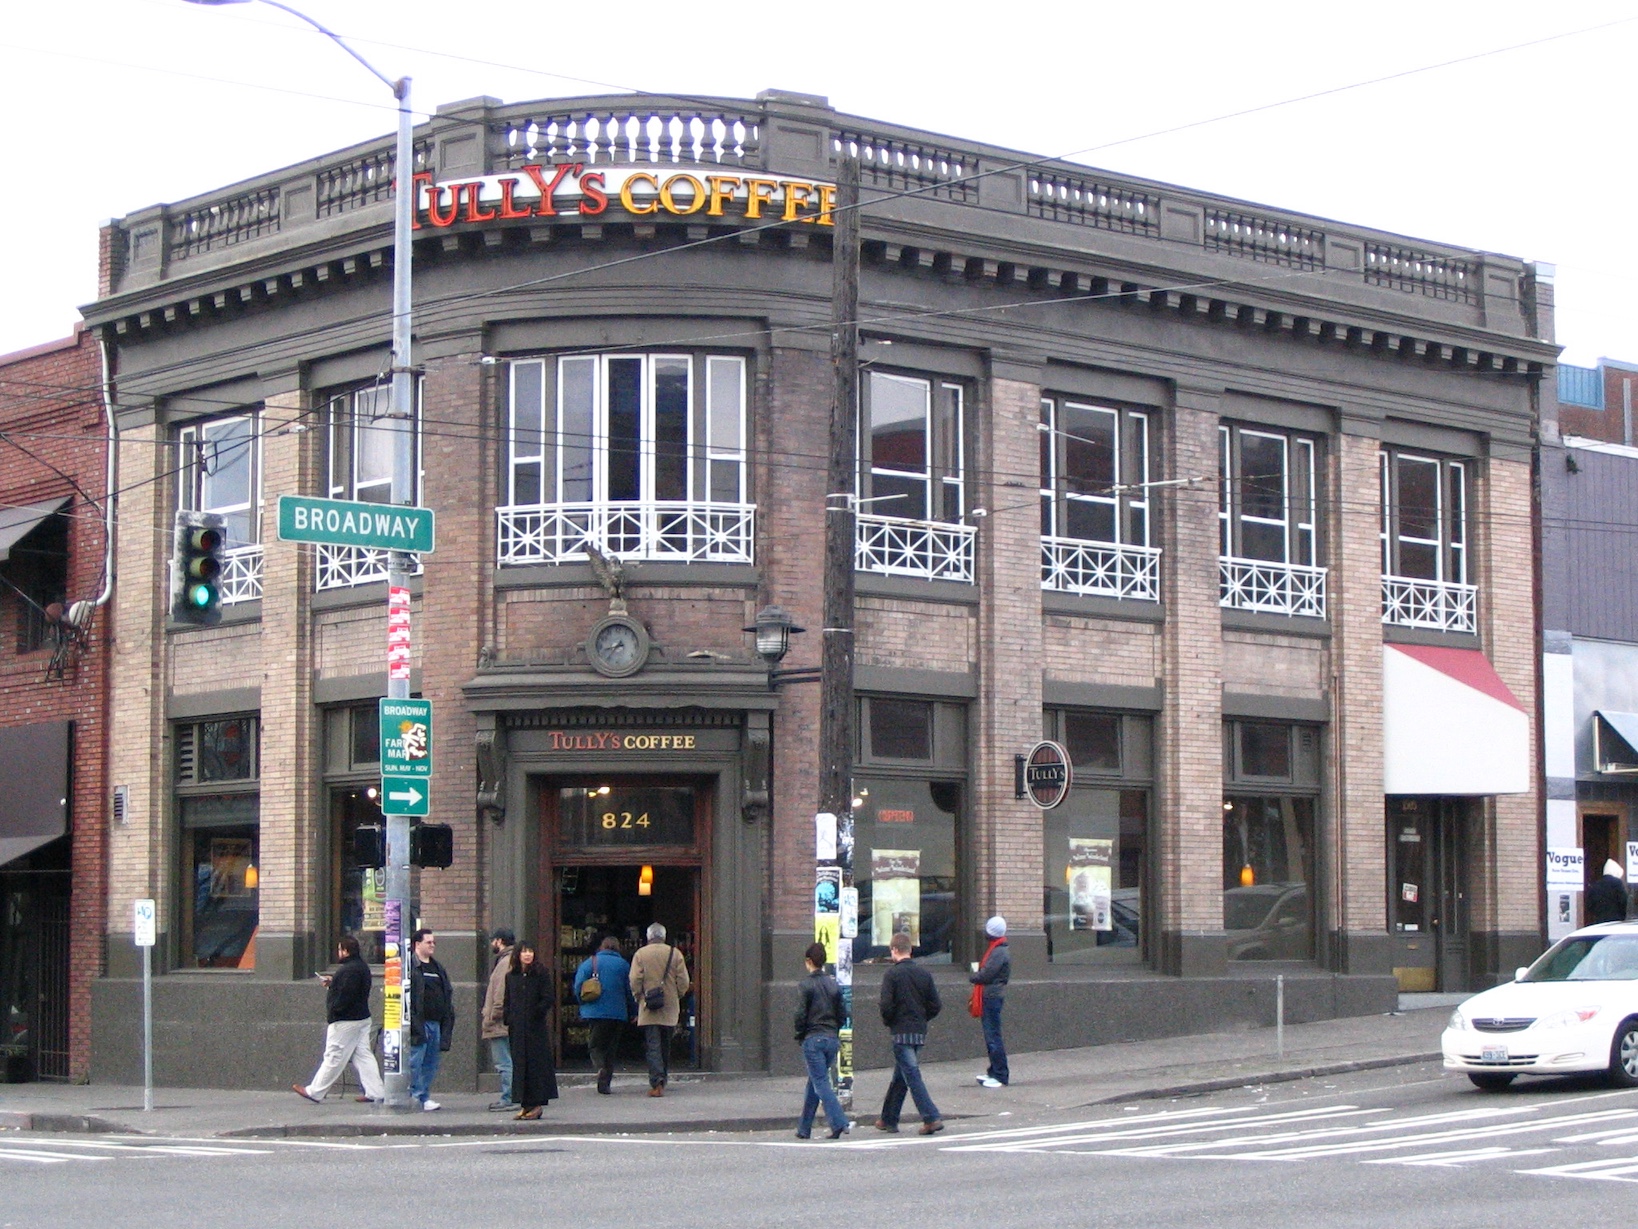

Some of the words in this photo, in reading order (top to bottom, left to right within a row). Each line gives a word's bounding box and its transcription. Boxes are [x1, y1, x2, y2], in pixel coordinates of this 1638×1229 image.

[294, 506, 419, 540] BROADWAY
[384, 705, 428, 717] BROADWAY
[548, 731, 621, 750] TULLY'S
[623, 735, 696, 749] COFFEE
[601, 812, 651, 829] 824
[1546, 851, 1583, 867] Vogue
